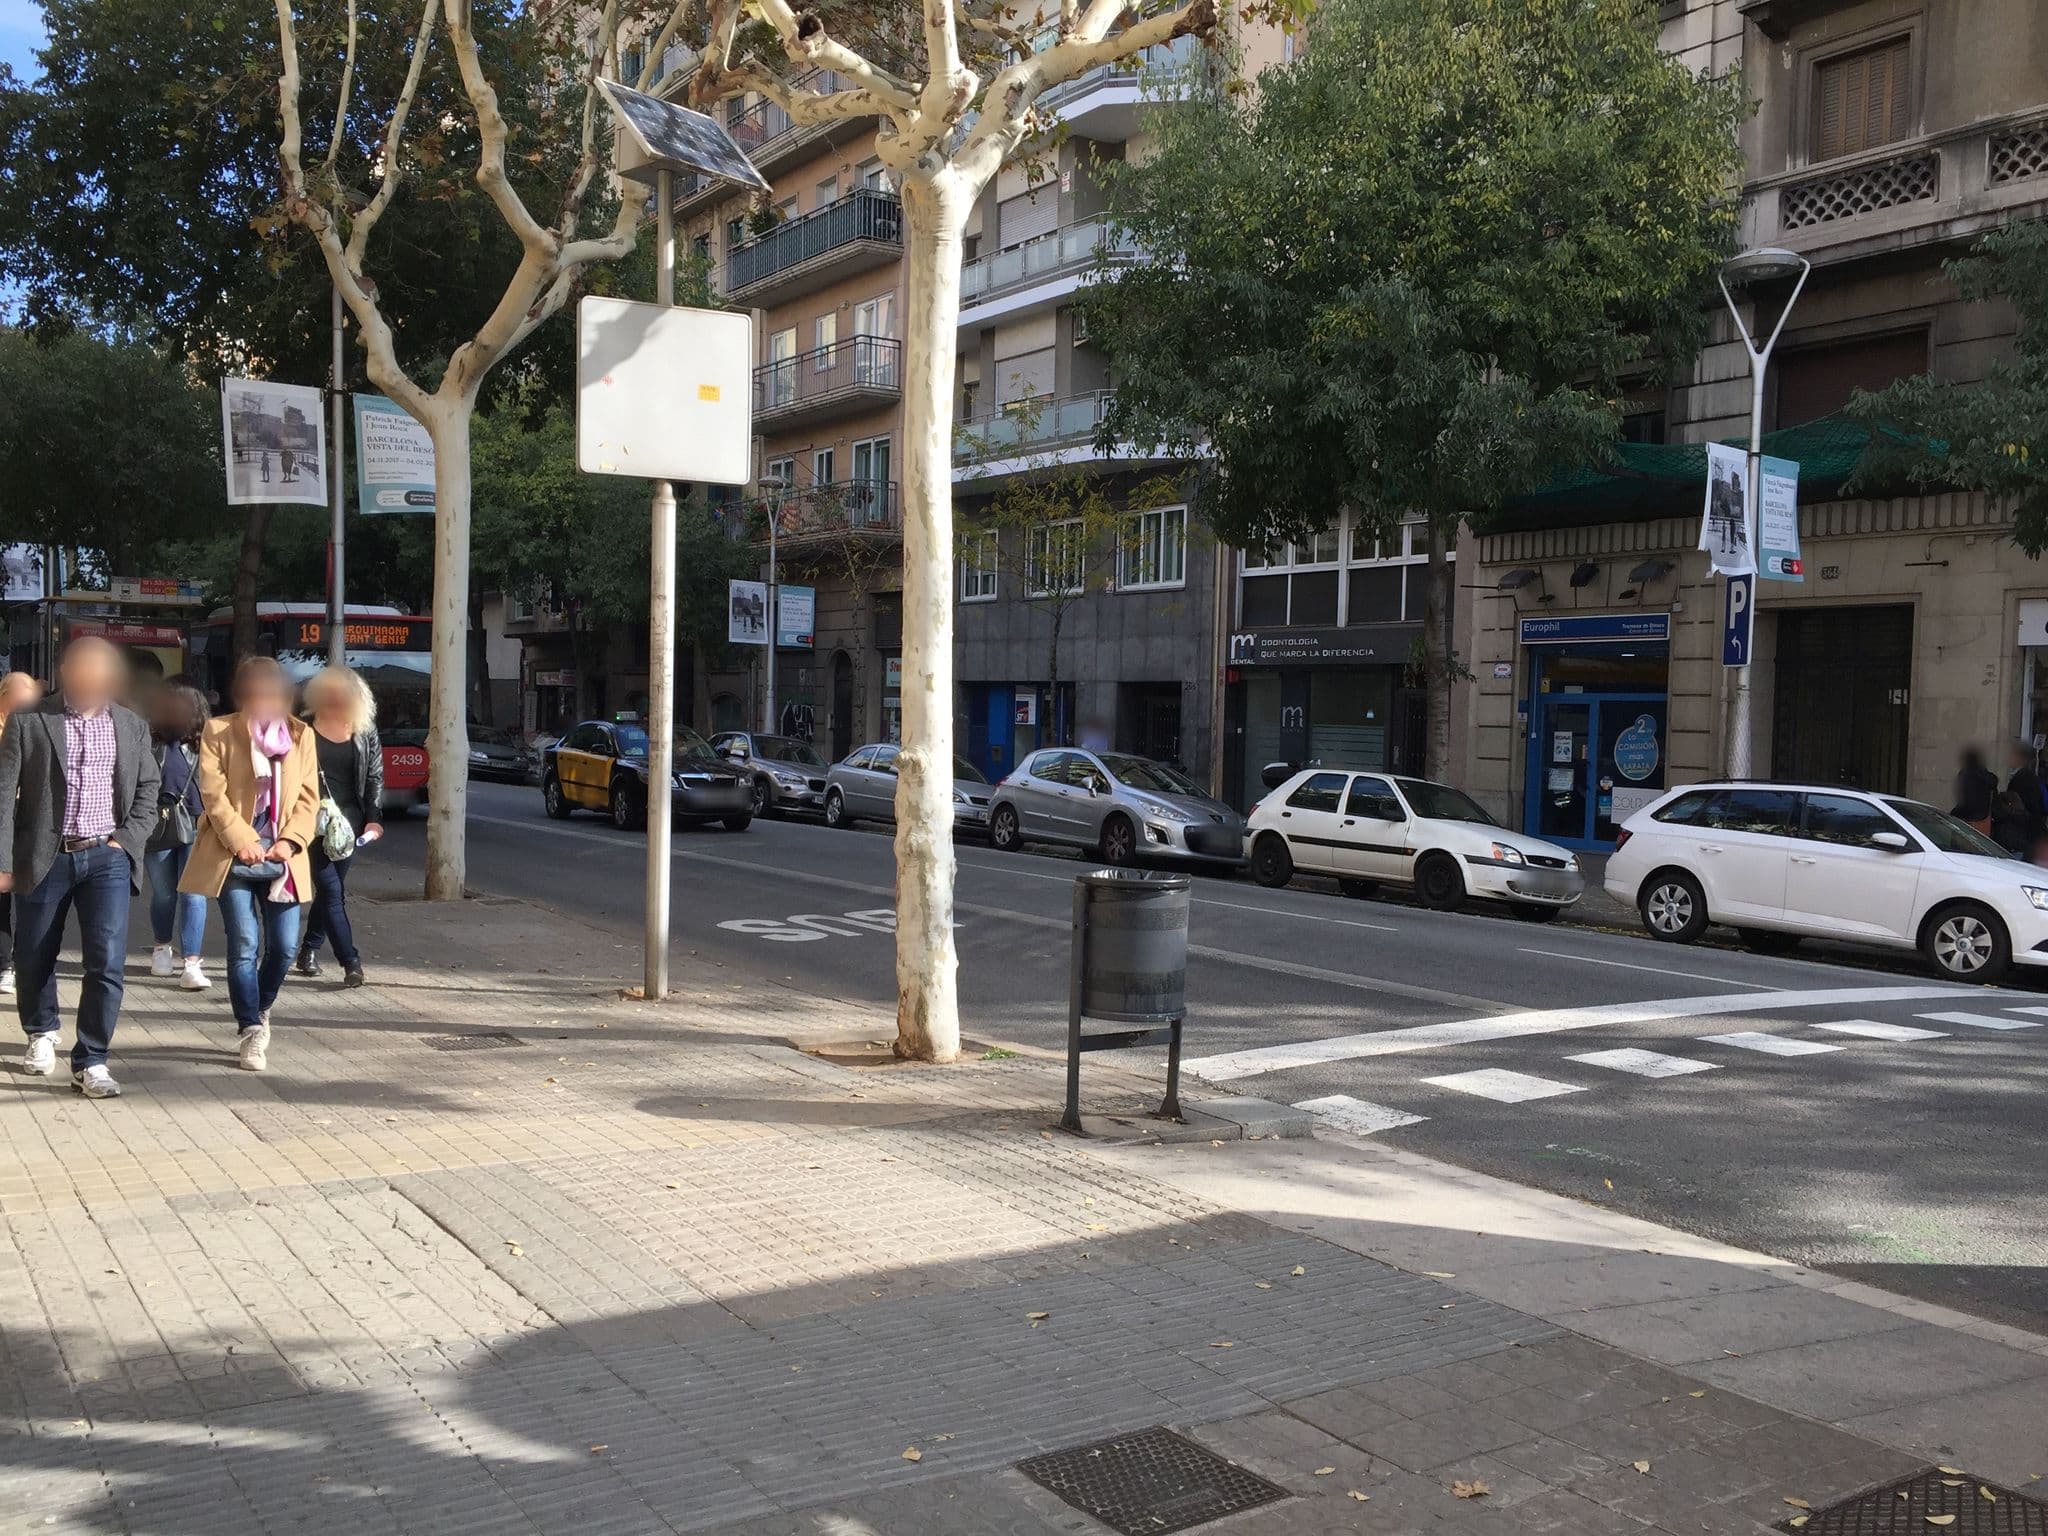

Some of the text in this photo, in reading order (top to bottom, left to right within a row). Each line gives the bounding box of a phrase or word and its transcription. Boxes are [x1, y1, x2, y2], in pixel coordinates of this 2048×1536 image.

[366, 436, 418, 446] BARCELONA
[366, 443, 392, 451] VISTA
[394, 445, 412, 453] DEL
[1729, 581, 1747, 629] P
[1523, 622, 1560, 633] Europhil
[300, 624, 320, 643] 19
[375, 636, 406, 644] GENIS
[1260, 650, 1277, 658] QUE
[1279, 650, 1307, 658] MARCA
[1322, 649, 1375, 657] DIFERENCIA
[1637, 719, 1646, 733] 2
[391, 754, 423, 765] 2439
